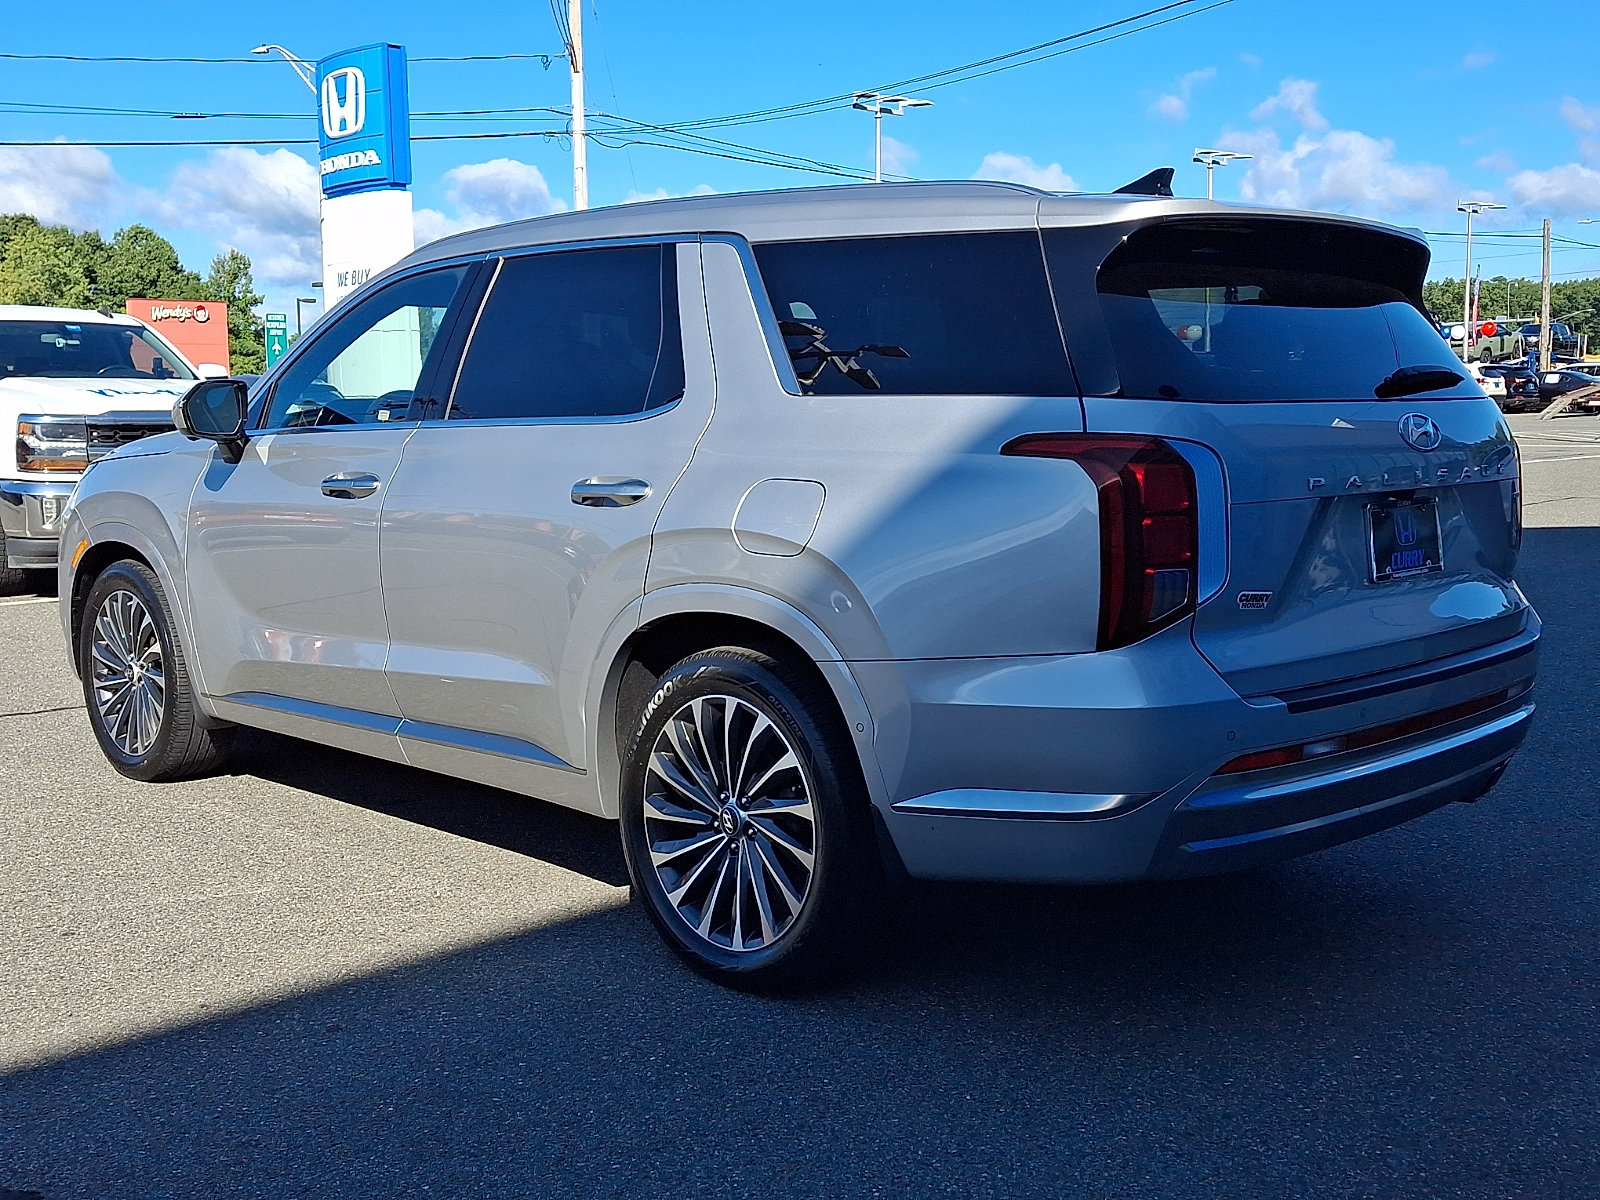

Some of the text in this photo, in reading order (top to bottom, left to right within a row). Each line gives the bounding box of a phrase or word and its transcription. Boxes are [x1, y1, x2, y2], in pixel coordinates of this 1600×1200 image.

[320, 149, 381, 175] HONDA
[337, 268, 371, 287] WE BUY
[151, 304, 192, 322] Wendy's
[1391, 549, 1425, 570] CURRY
[1238, 593, 1271, 602] CURRY
